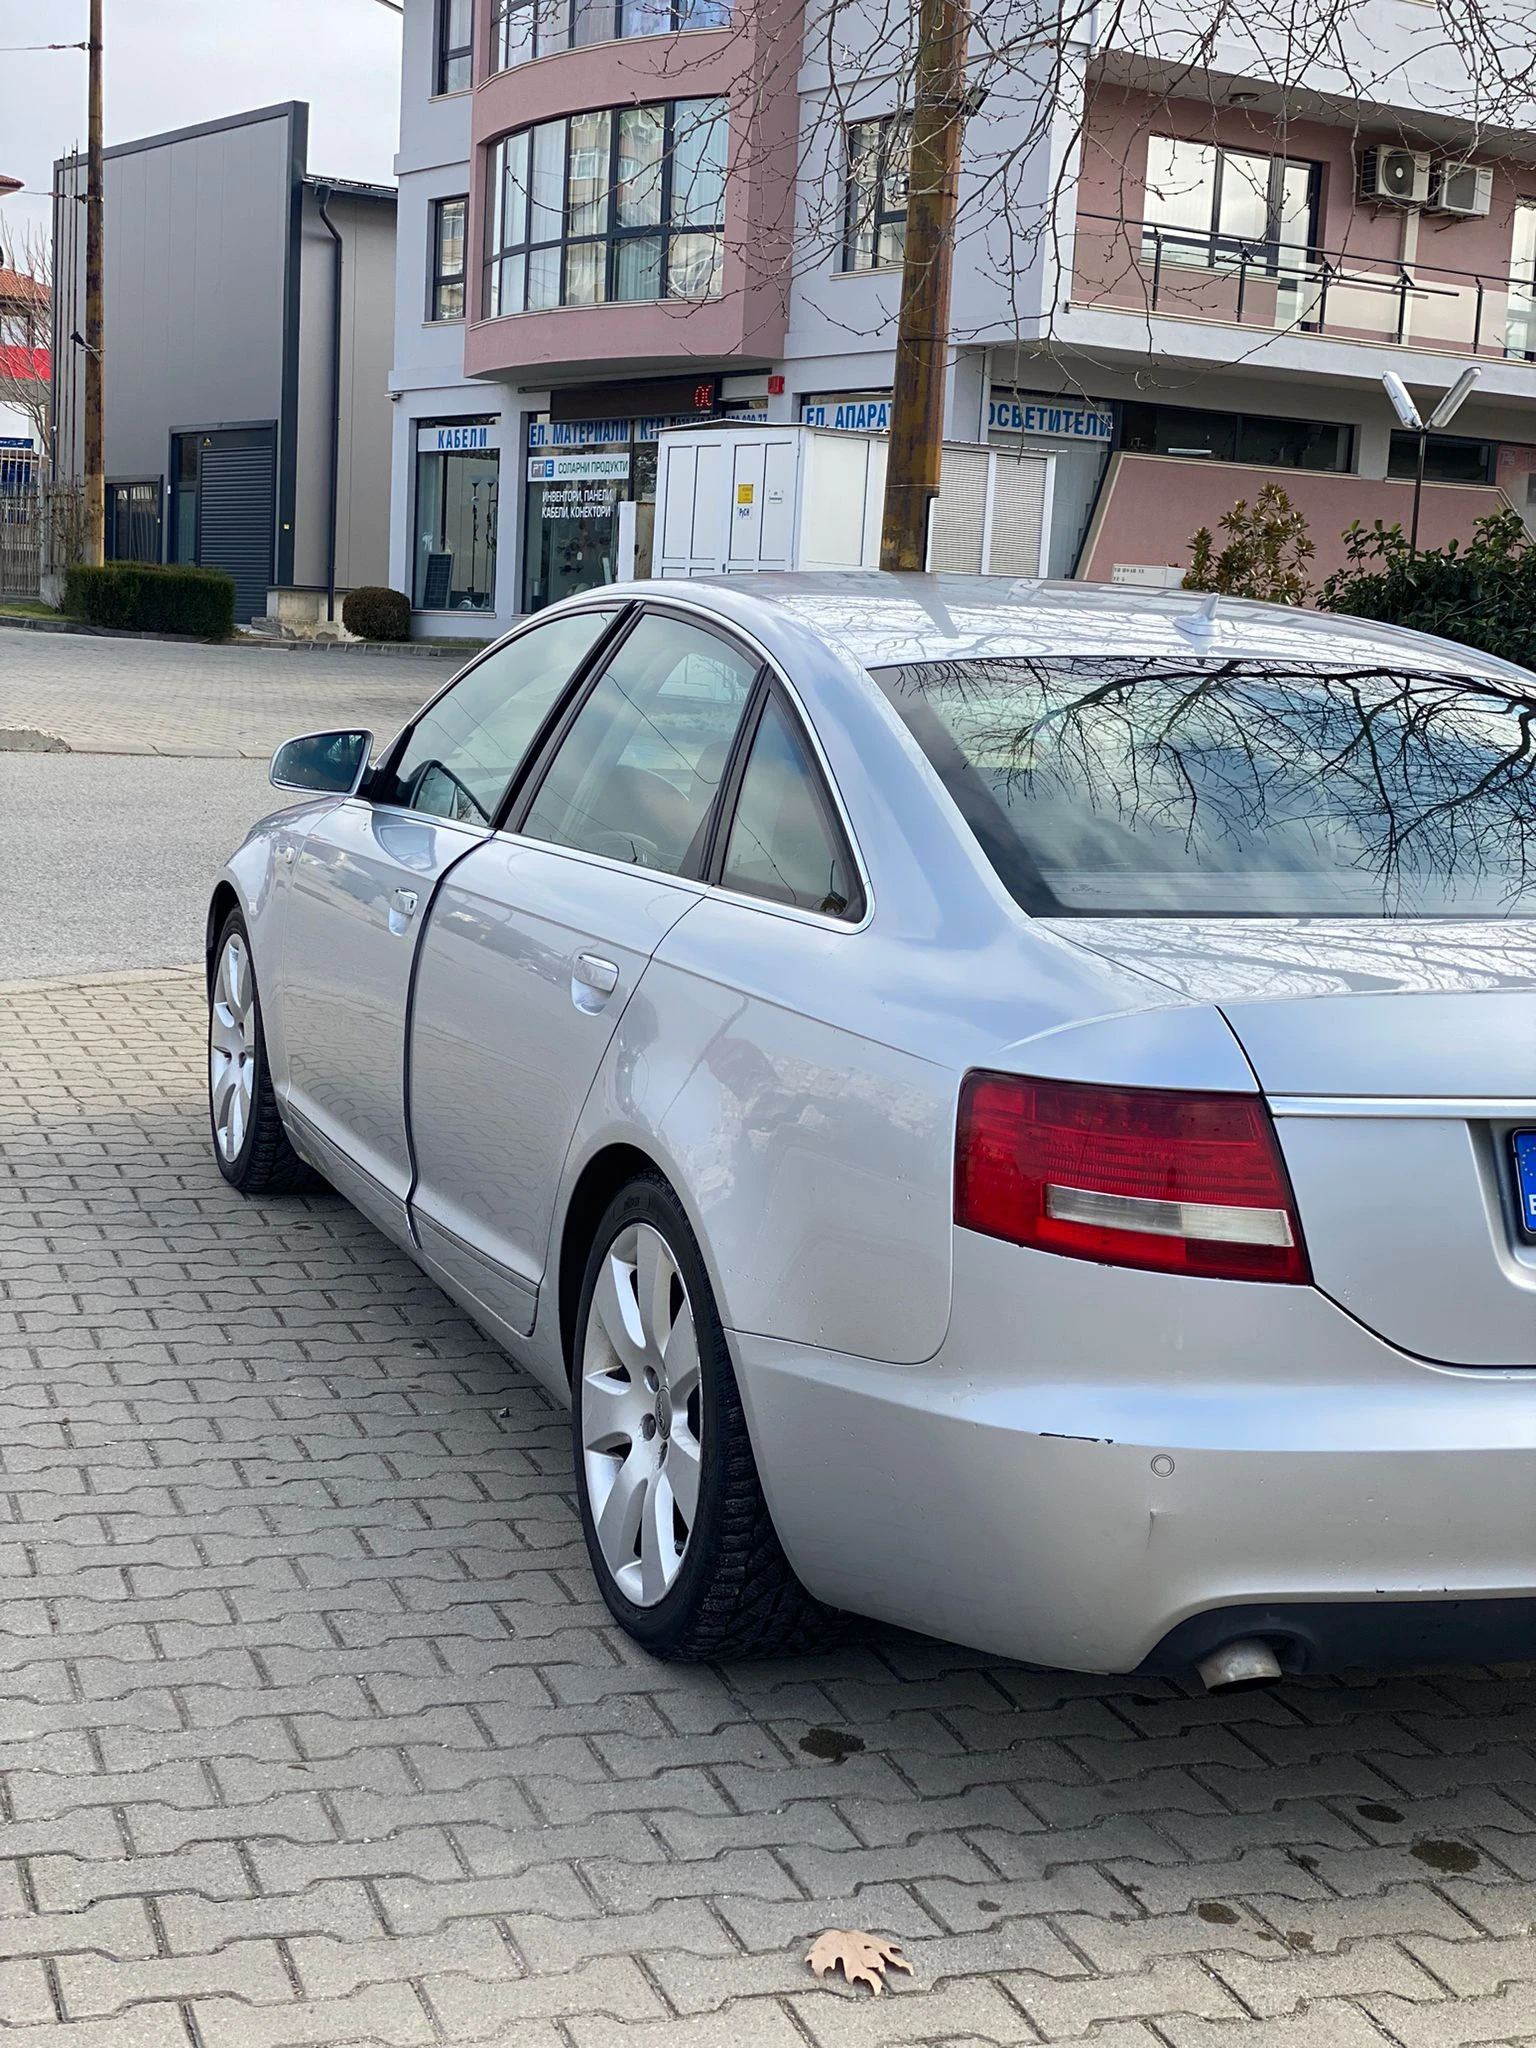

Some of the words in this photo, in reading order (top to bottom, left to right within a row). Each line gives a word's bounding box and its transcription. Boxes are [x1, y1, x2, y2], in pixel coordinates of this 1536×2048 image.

[438, 428, 487, 449] КАБЕЛИ
[530, 424, 549, 445] ЕЛ.
[553, 420, 629, 444] МАТЕРИАЛИ
[558, 461, 590, 474] СОЛАРНИ
[591, 460, 628, 474] ПРОДУКТИ
[571, 505, 610, 518] КОНЕКТОРИ
